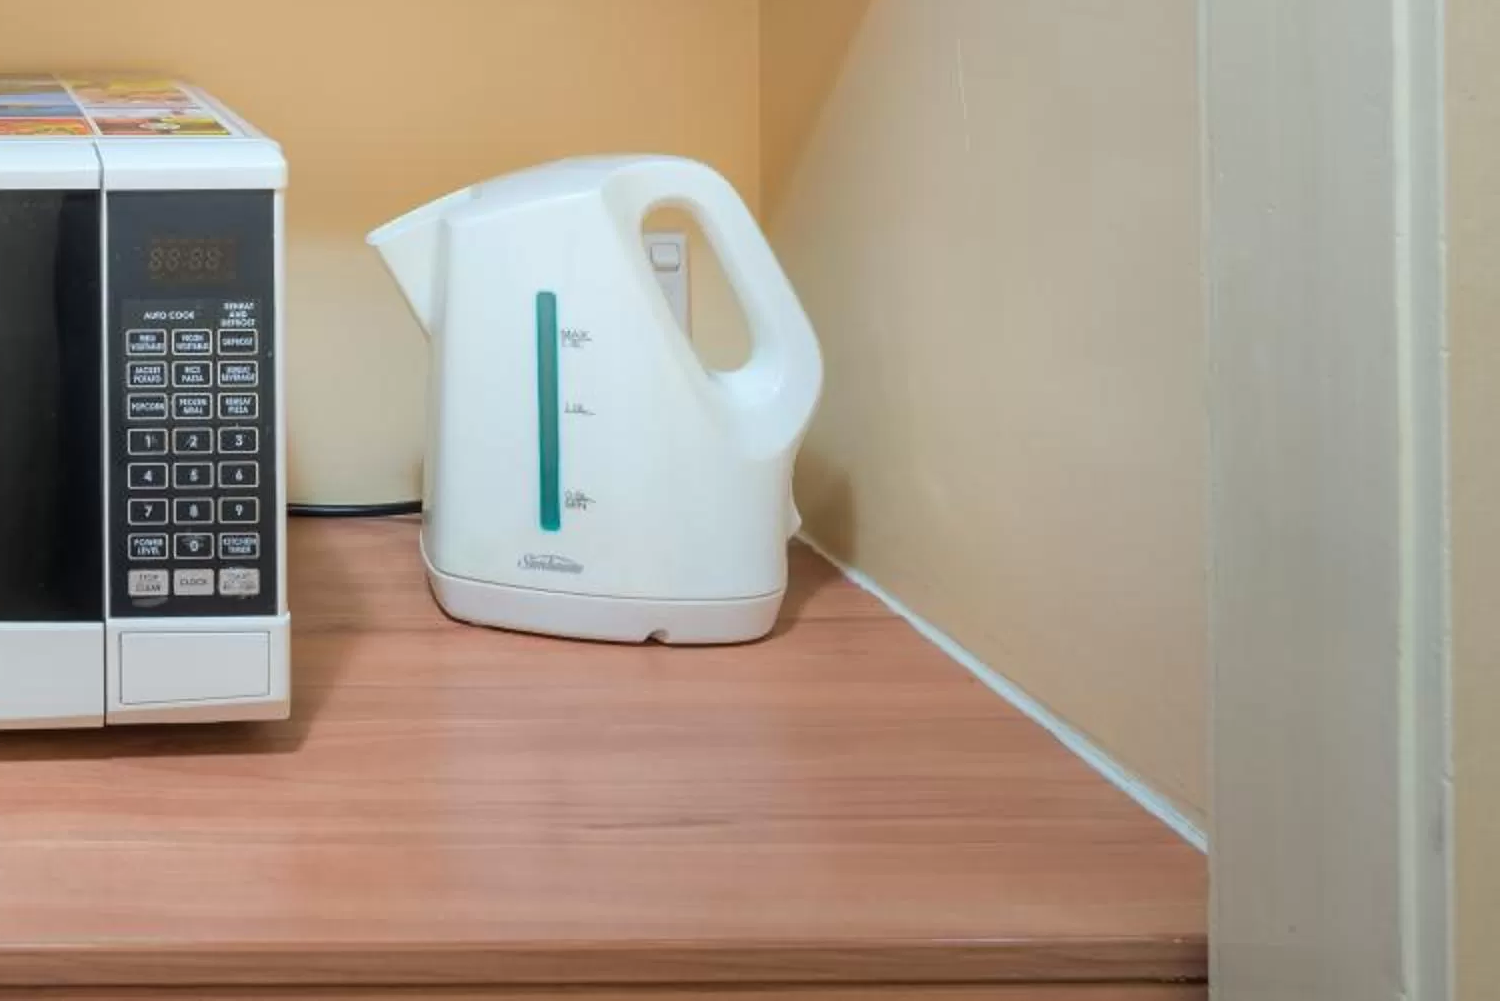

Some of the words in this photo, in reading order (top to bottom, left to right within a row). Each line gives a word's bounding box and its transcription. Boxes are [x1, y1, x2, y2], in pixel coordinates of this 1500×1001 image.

[188, 434, 198, 448] 2
[235, 434, 243, 447] 3
[143, 469, 153, 483] 4
[144, 503, 154, 518] 7
[235, 503, 243, 517] 9
